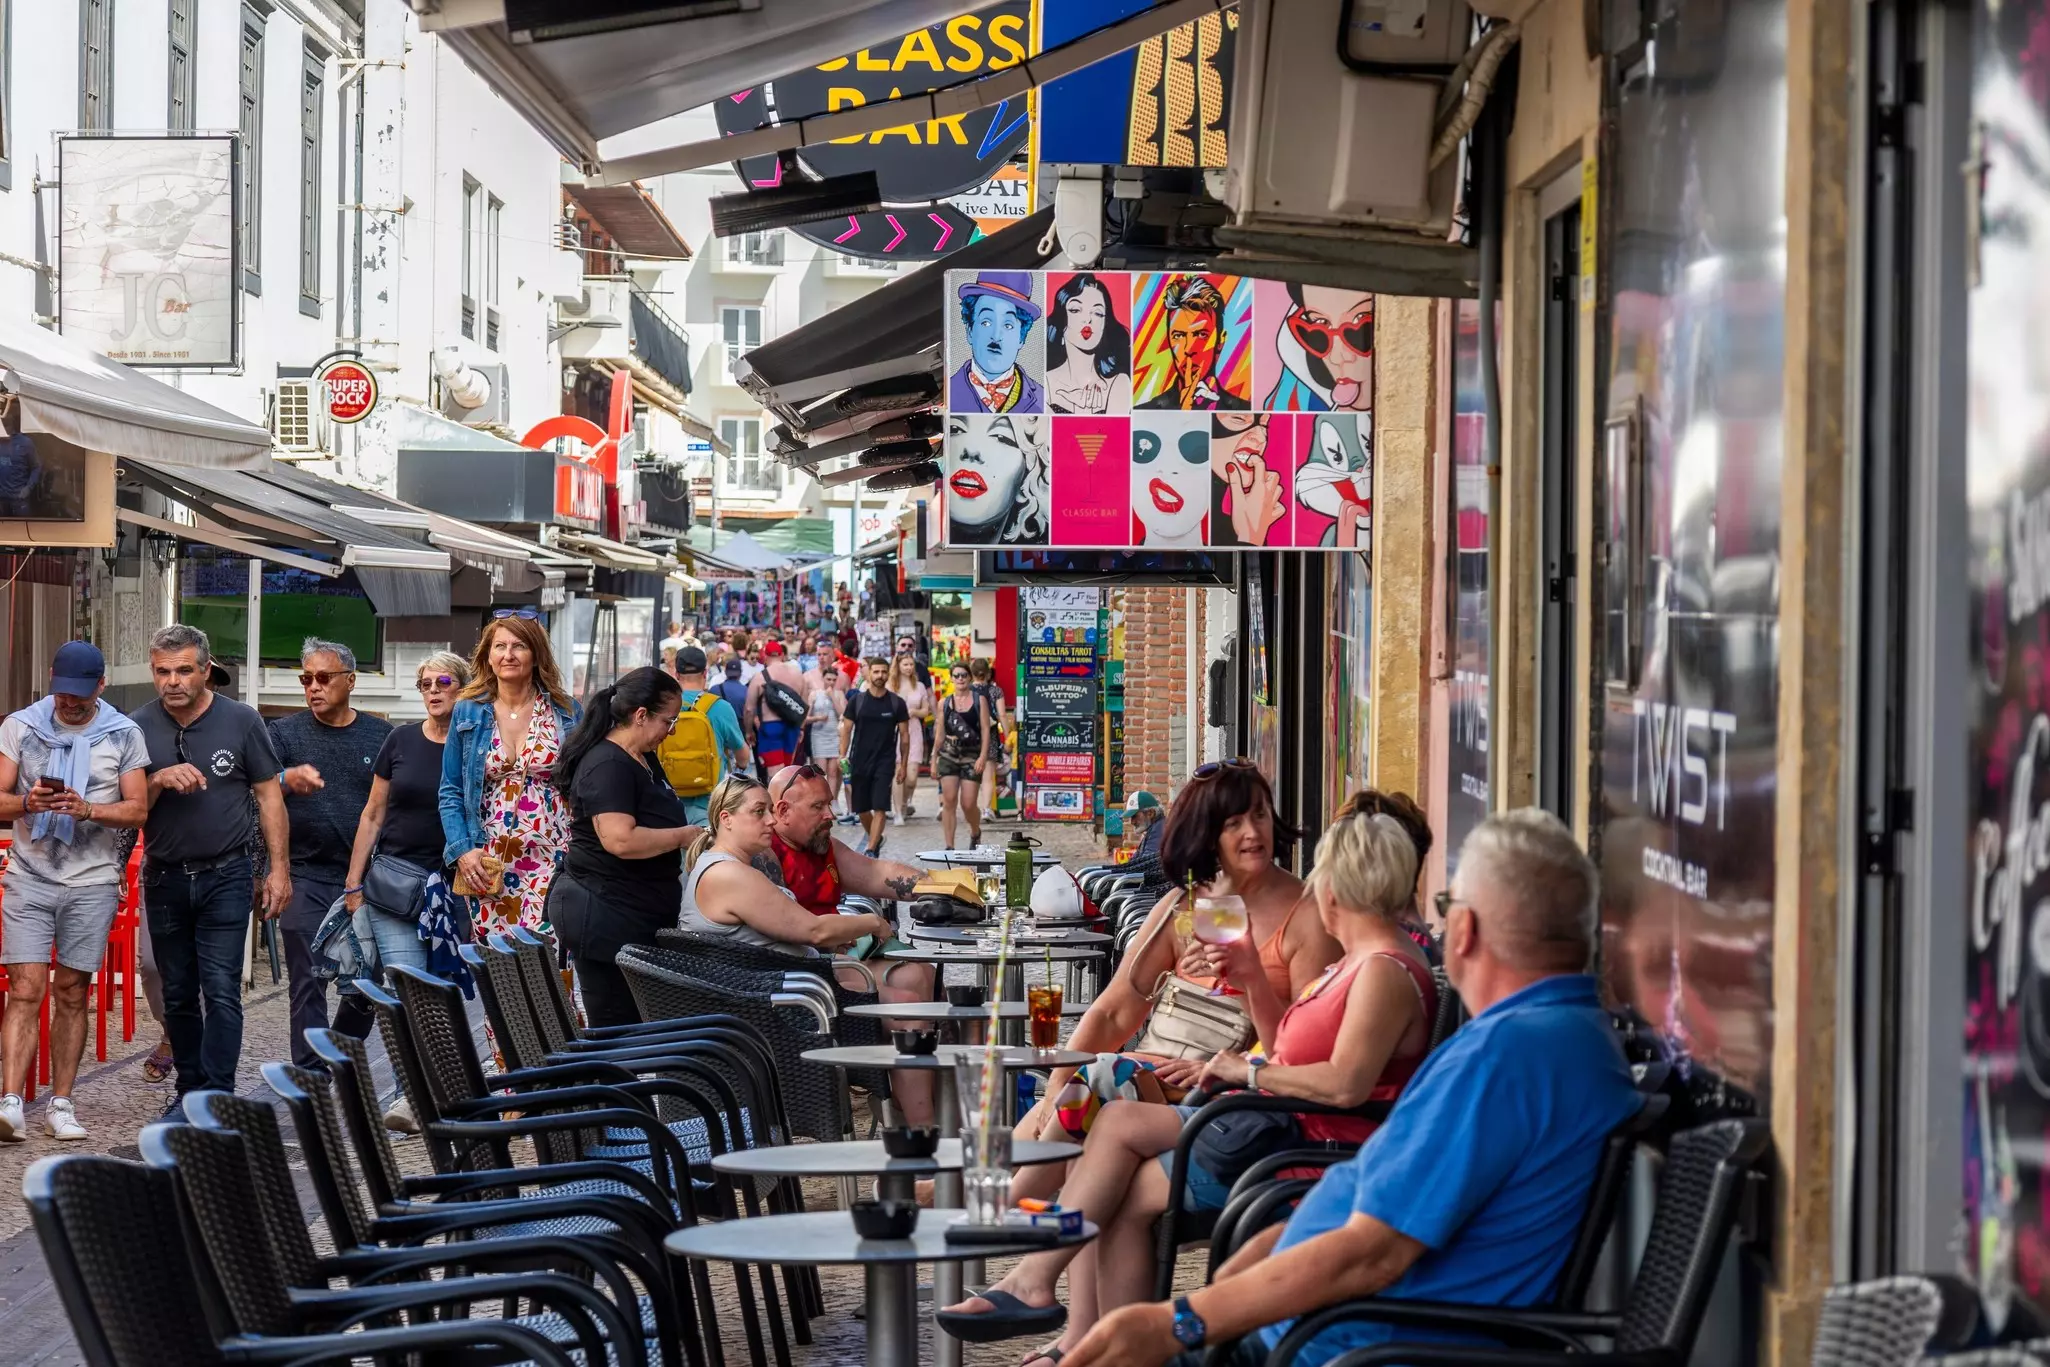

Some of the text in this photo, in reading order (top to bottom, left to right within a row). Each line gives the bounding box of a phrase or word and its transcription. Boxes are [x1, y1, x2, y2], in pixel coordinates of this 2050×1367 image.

[816, 14, 1026, 73] LASS
[828, 87, 969, 145] BAR
[956, 202, 1028, 216] Live Mus
[109, 272, 187, 341] JC
[325, 379, 368, 392] SUPER
[330, 391, 366, 405] BOCK
[1062, 508, 1118, 517] CLASSIC BAR
[1030, 646, 1093, 656] CONSULTAS TAROT
[1035, 684, 1088, 694] ALBUFEIRA
[1455, 670, 1489, 752] TWIS
[1041, 734, 1079, 745] CANNABIS
[1632, 699, 1738, 832] TWIST
[1643, 846, 1708, 900] COCKTAIL BAR
